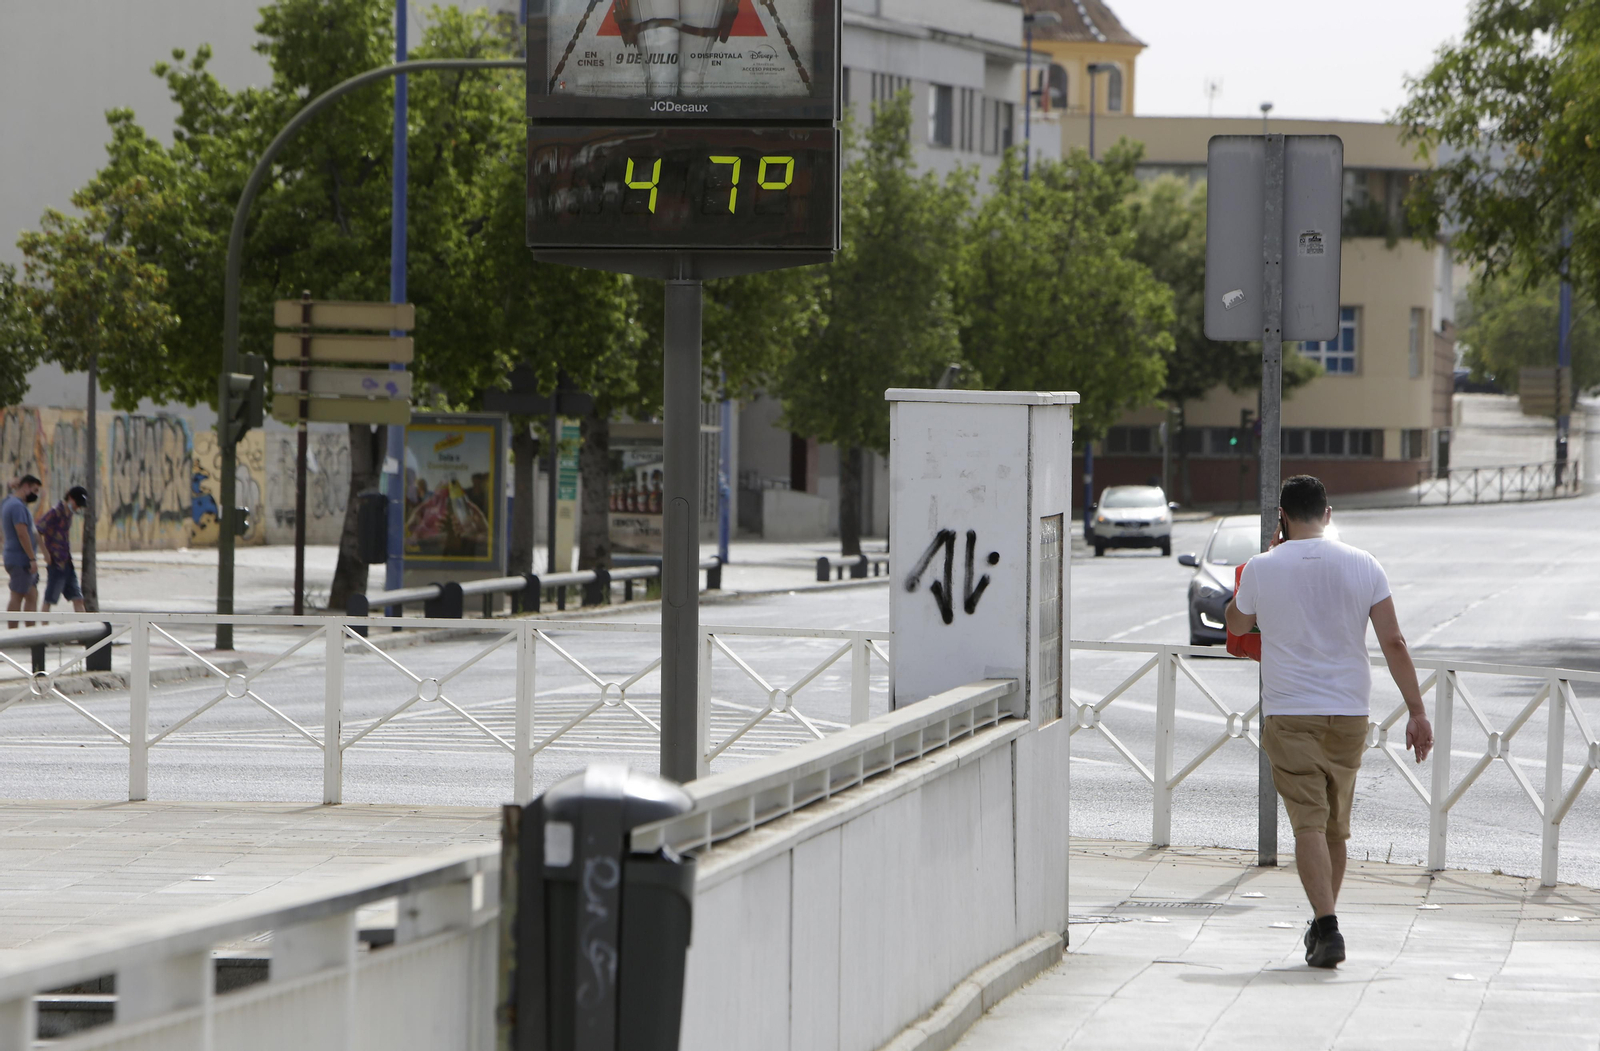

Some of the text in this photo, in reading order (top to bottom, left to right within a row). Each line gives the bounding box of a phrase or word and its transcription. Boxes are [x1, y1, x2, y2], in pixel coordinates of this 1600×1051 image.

[584, 51, 598, 59] EN
[615, 53, 679, 64] 9 DE JULIO
[697, 51, 743, 59] DISFRÚTALA
[577, 59, 605, 67] CINES
[650, 101, 709, 113] JCDecaux
